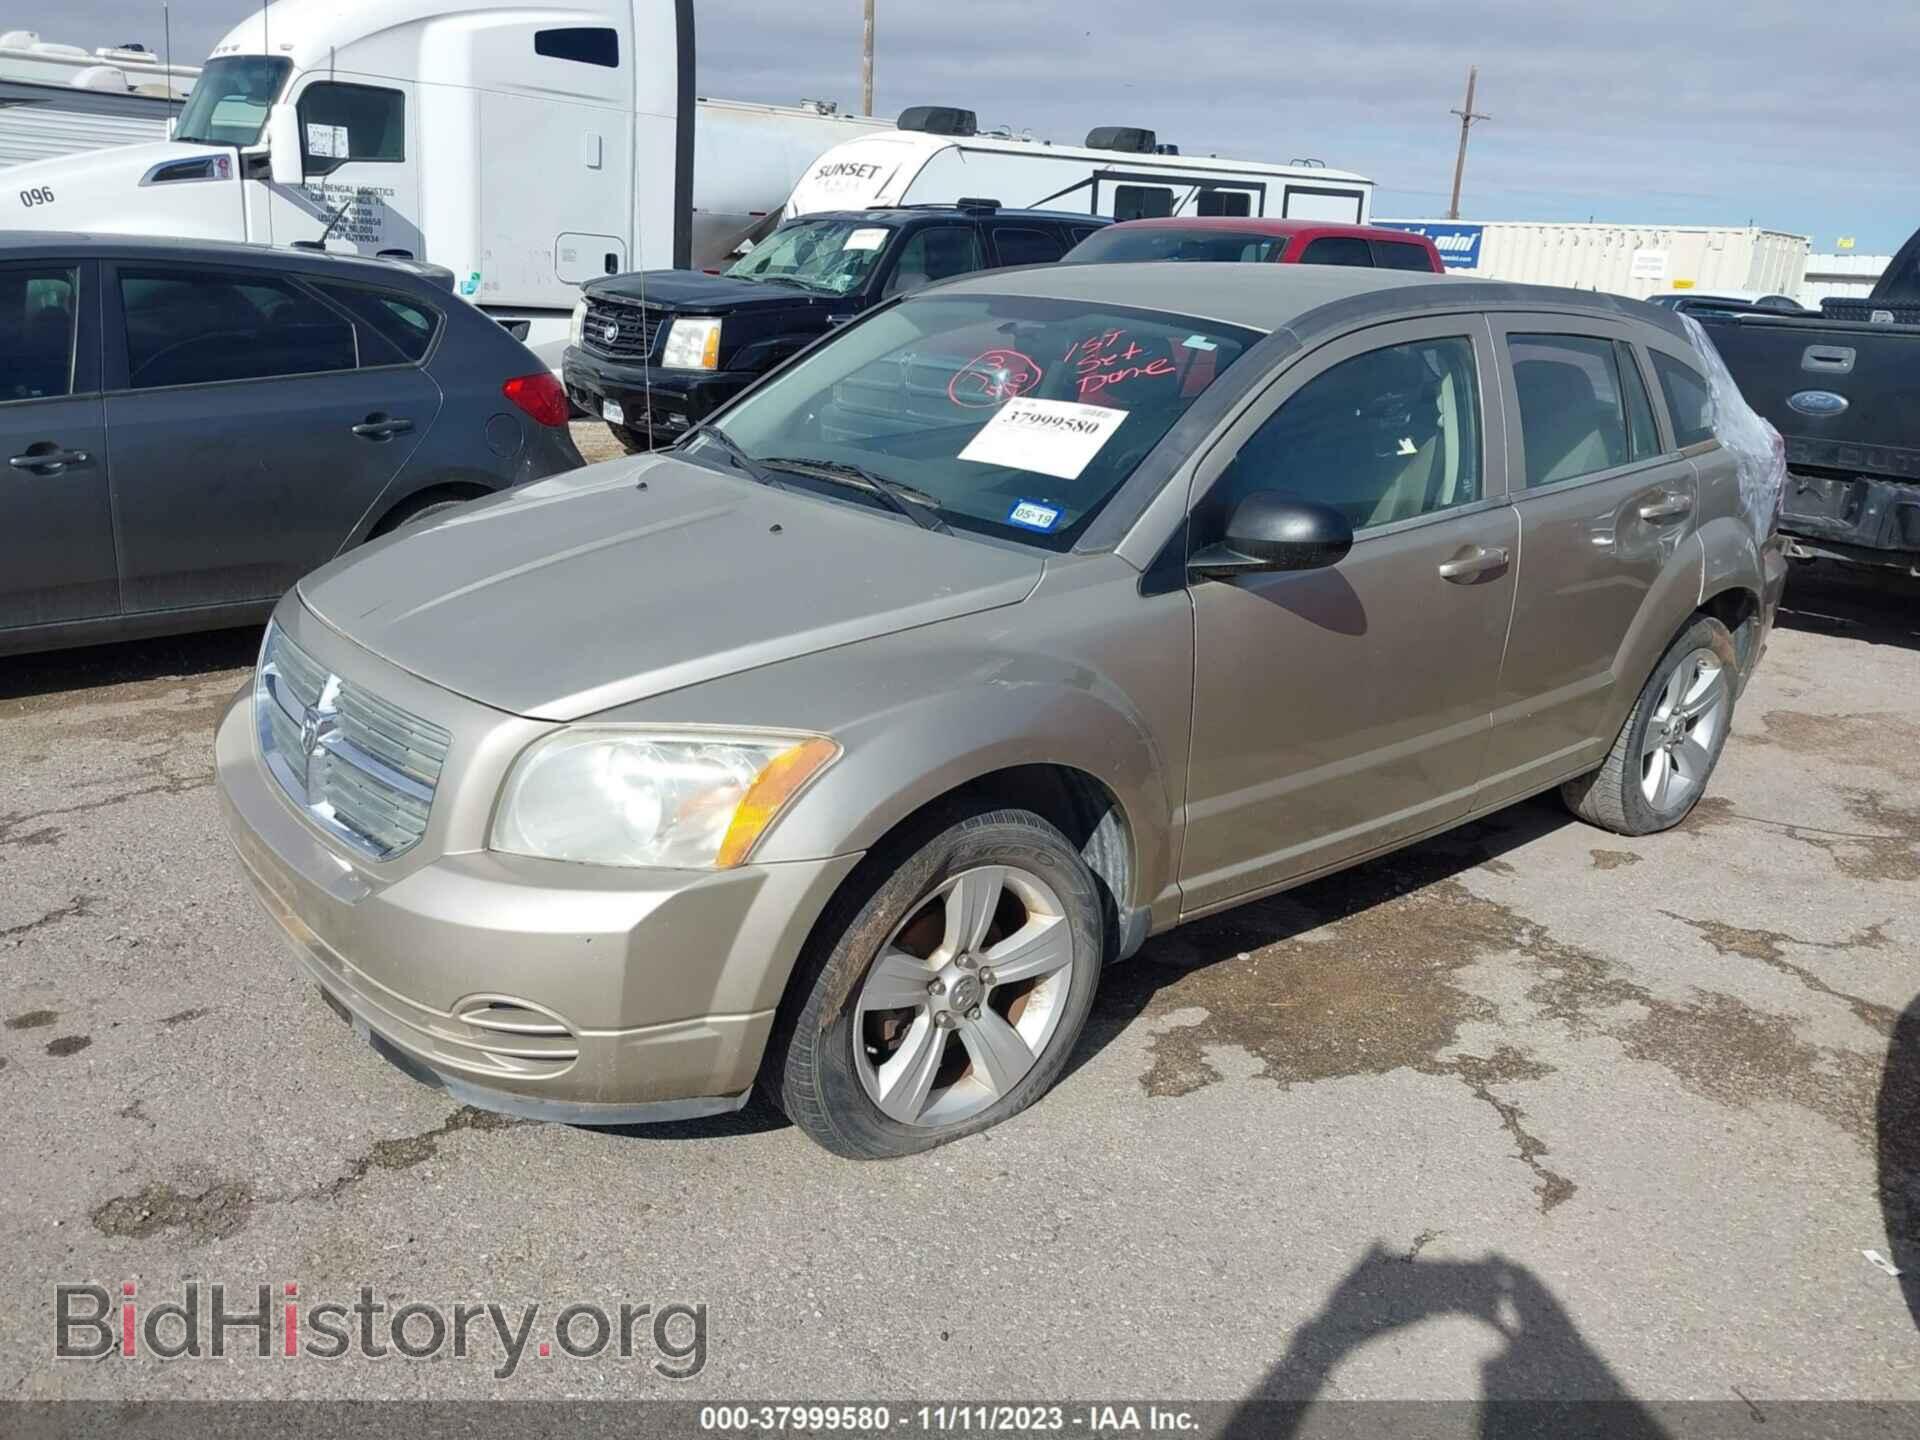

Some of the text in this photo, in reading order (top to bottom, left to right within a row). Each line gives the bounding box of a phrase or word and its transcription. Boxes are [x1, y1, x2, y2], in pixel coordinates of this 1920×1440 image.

[816, 163, 882, 180] SUNSET
[20, 186, 55, 208] 096
[1434, 233, 1480, 252] mini
[1076, 358, 1176, 393] Done
[1003, 410, 1100, 435] 37999580
